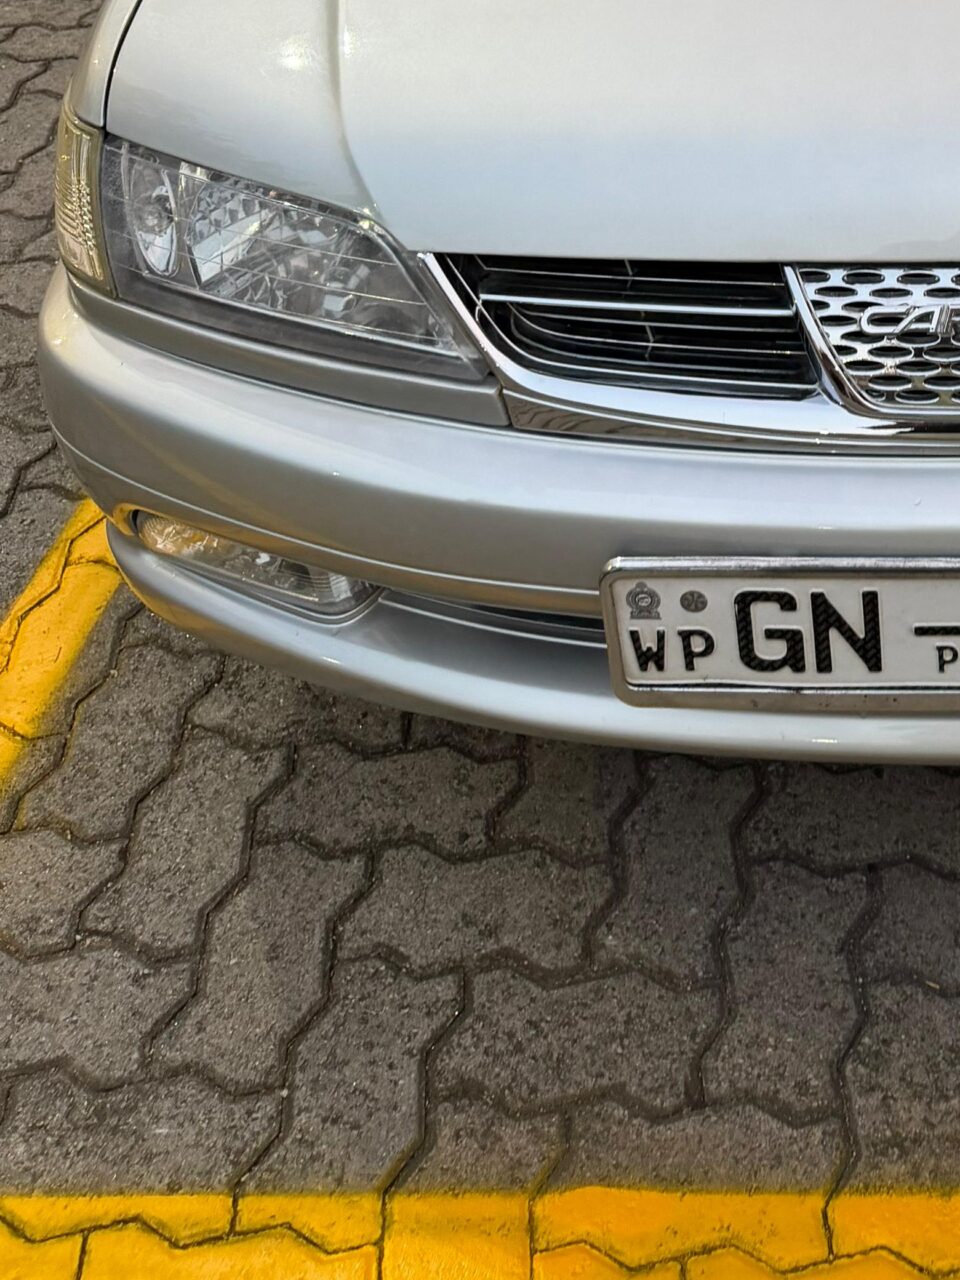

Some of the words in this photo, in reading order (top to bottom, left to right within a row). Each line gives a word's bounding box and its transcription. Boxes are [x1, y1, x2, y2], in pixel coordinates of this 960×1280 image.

[629, 629, 715, 672] WP
[734, 589, 883, 674] GN
[935, 645, 959, 673] P
